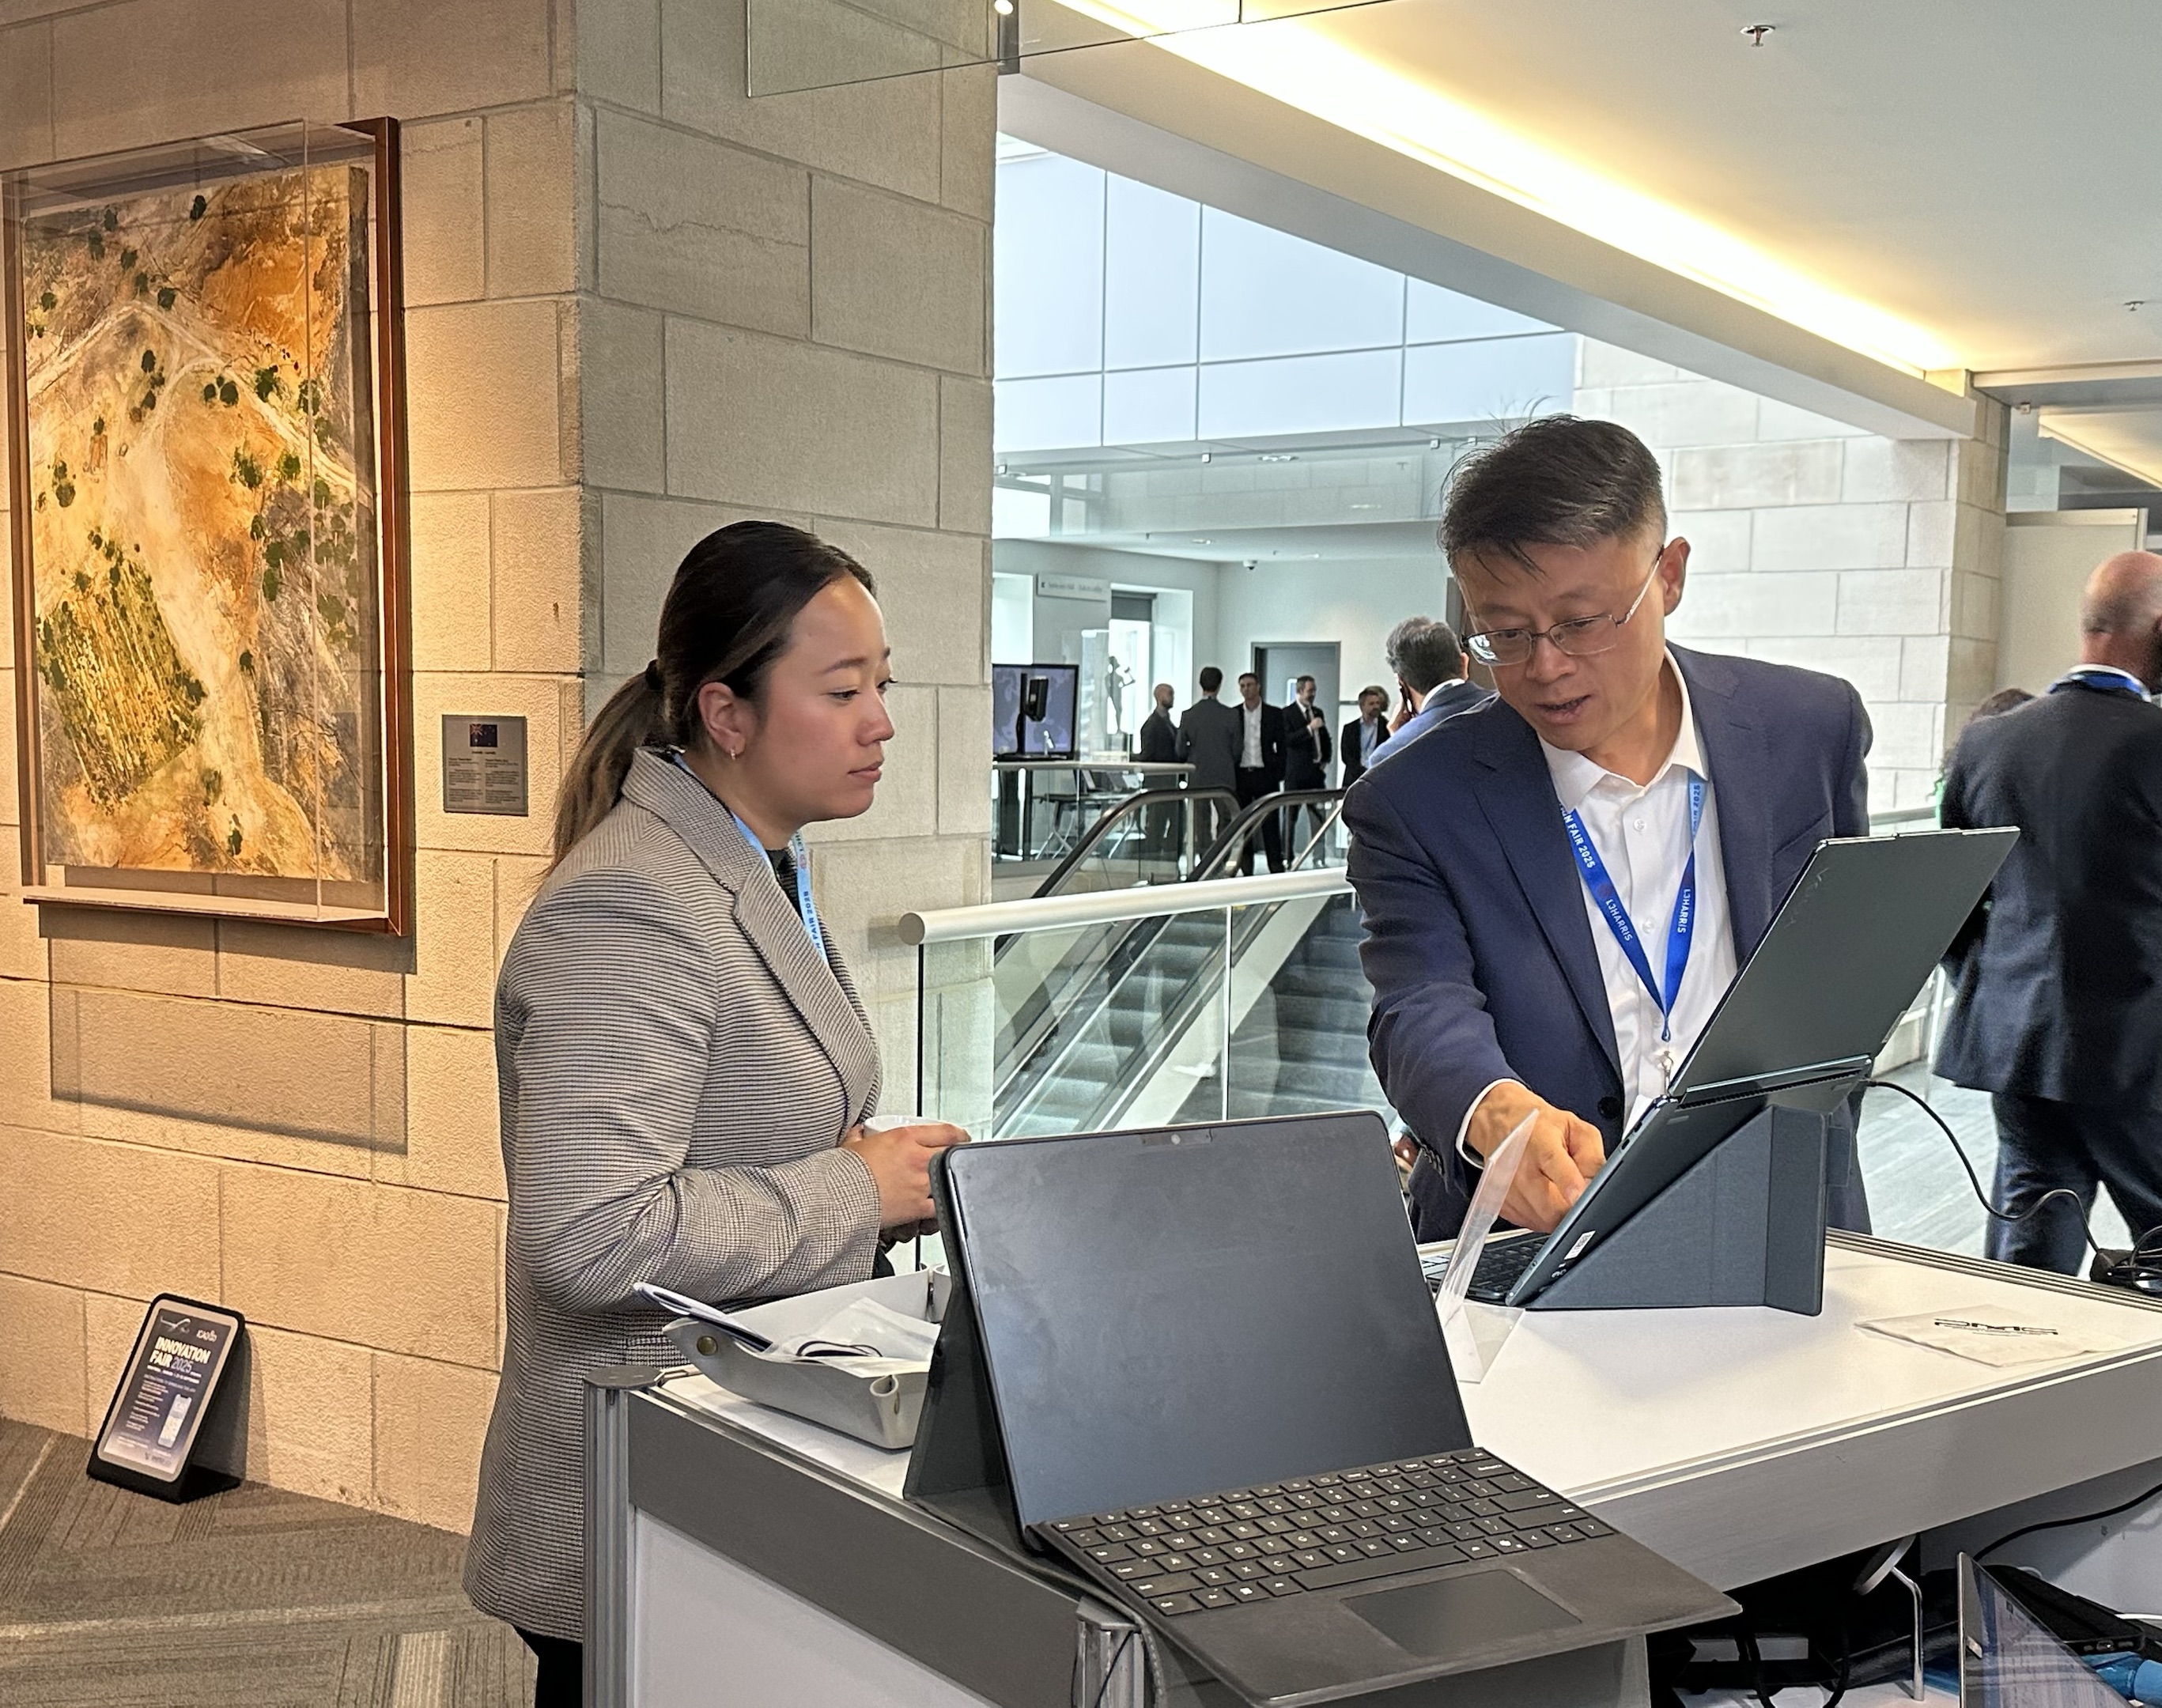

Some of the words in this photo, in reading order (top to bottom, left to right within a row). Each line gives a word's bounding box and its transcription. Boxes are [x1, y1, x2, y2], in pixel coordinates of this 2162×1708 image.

[1567, 823, 1584, 845] FAIR
[1578, 845, 1596, 867] 2025
[1605, 899, 1633, 941] L3HARRIS
[1677, 889, 1691, 933] L3HARRIS
[149, 1350, 173, 1368] FAIR
[171, 1356, 194, 1374] 2025
[155, 1336, 211, 1364] INNOVATION
